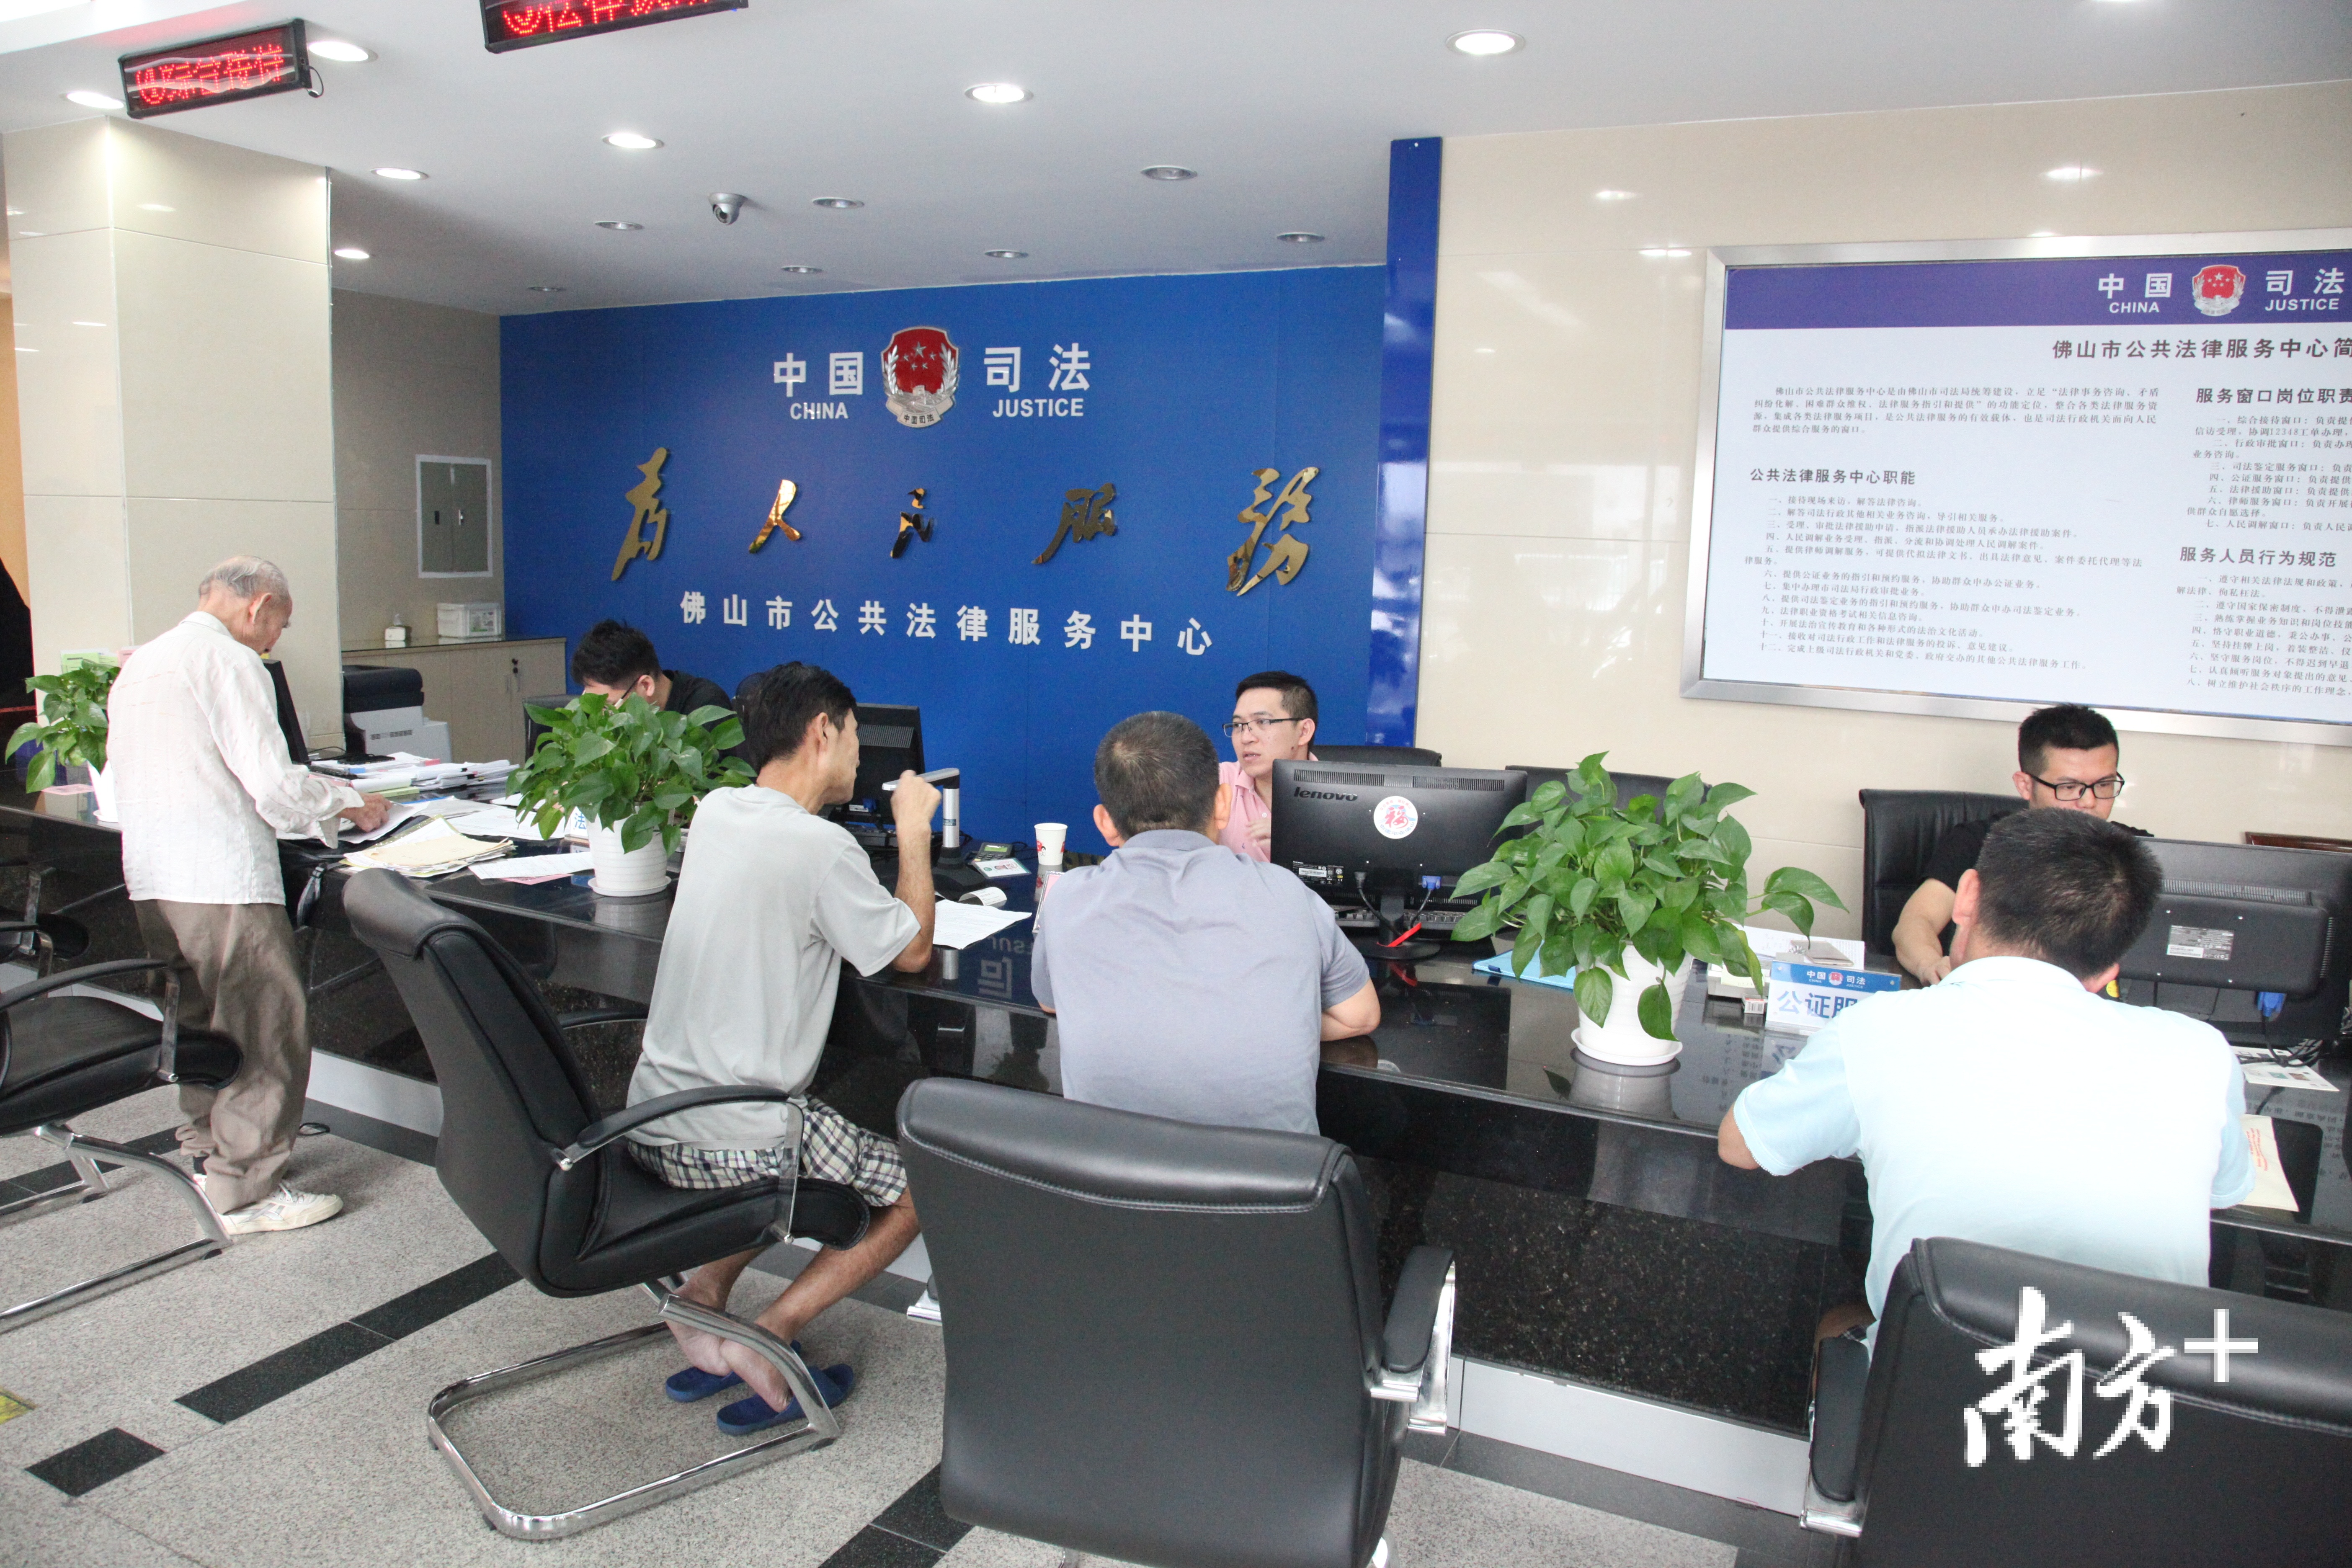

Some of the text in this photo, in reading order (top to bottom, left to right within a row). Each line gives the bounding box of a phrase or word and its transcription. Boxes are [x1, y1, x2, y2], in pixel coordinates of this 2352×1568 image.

[2109, 302, 2160, 314] CHINA
[2265, 298, 2339, 312] JUSTICE
[2196, 388, 2352, 404] 服务窗口岗位职责
[790, 402, 848, 420] CHINA
[993, 398, 1084, 418] JUSTICE
[904, 414, 934, 424] 中国司法
[1750, 468, 1916, 485] 公共法律服务中心职能
[2179, 547, 2337, 567] 服务人员行为规范
[681, 591, 1212, 656] 佛山市公共法律服务中心
[1294, 787, 1357, 802] lenovo
[574, 812, 586, 830] 法
